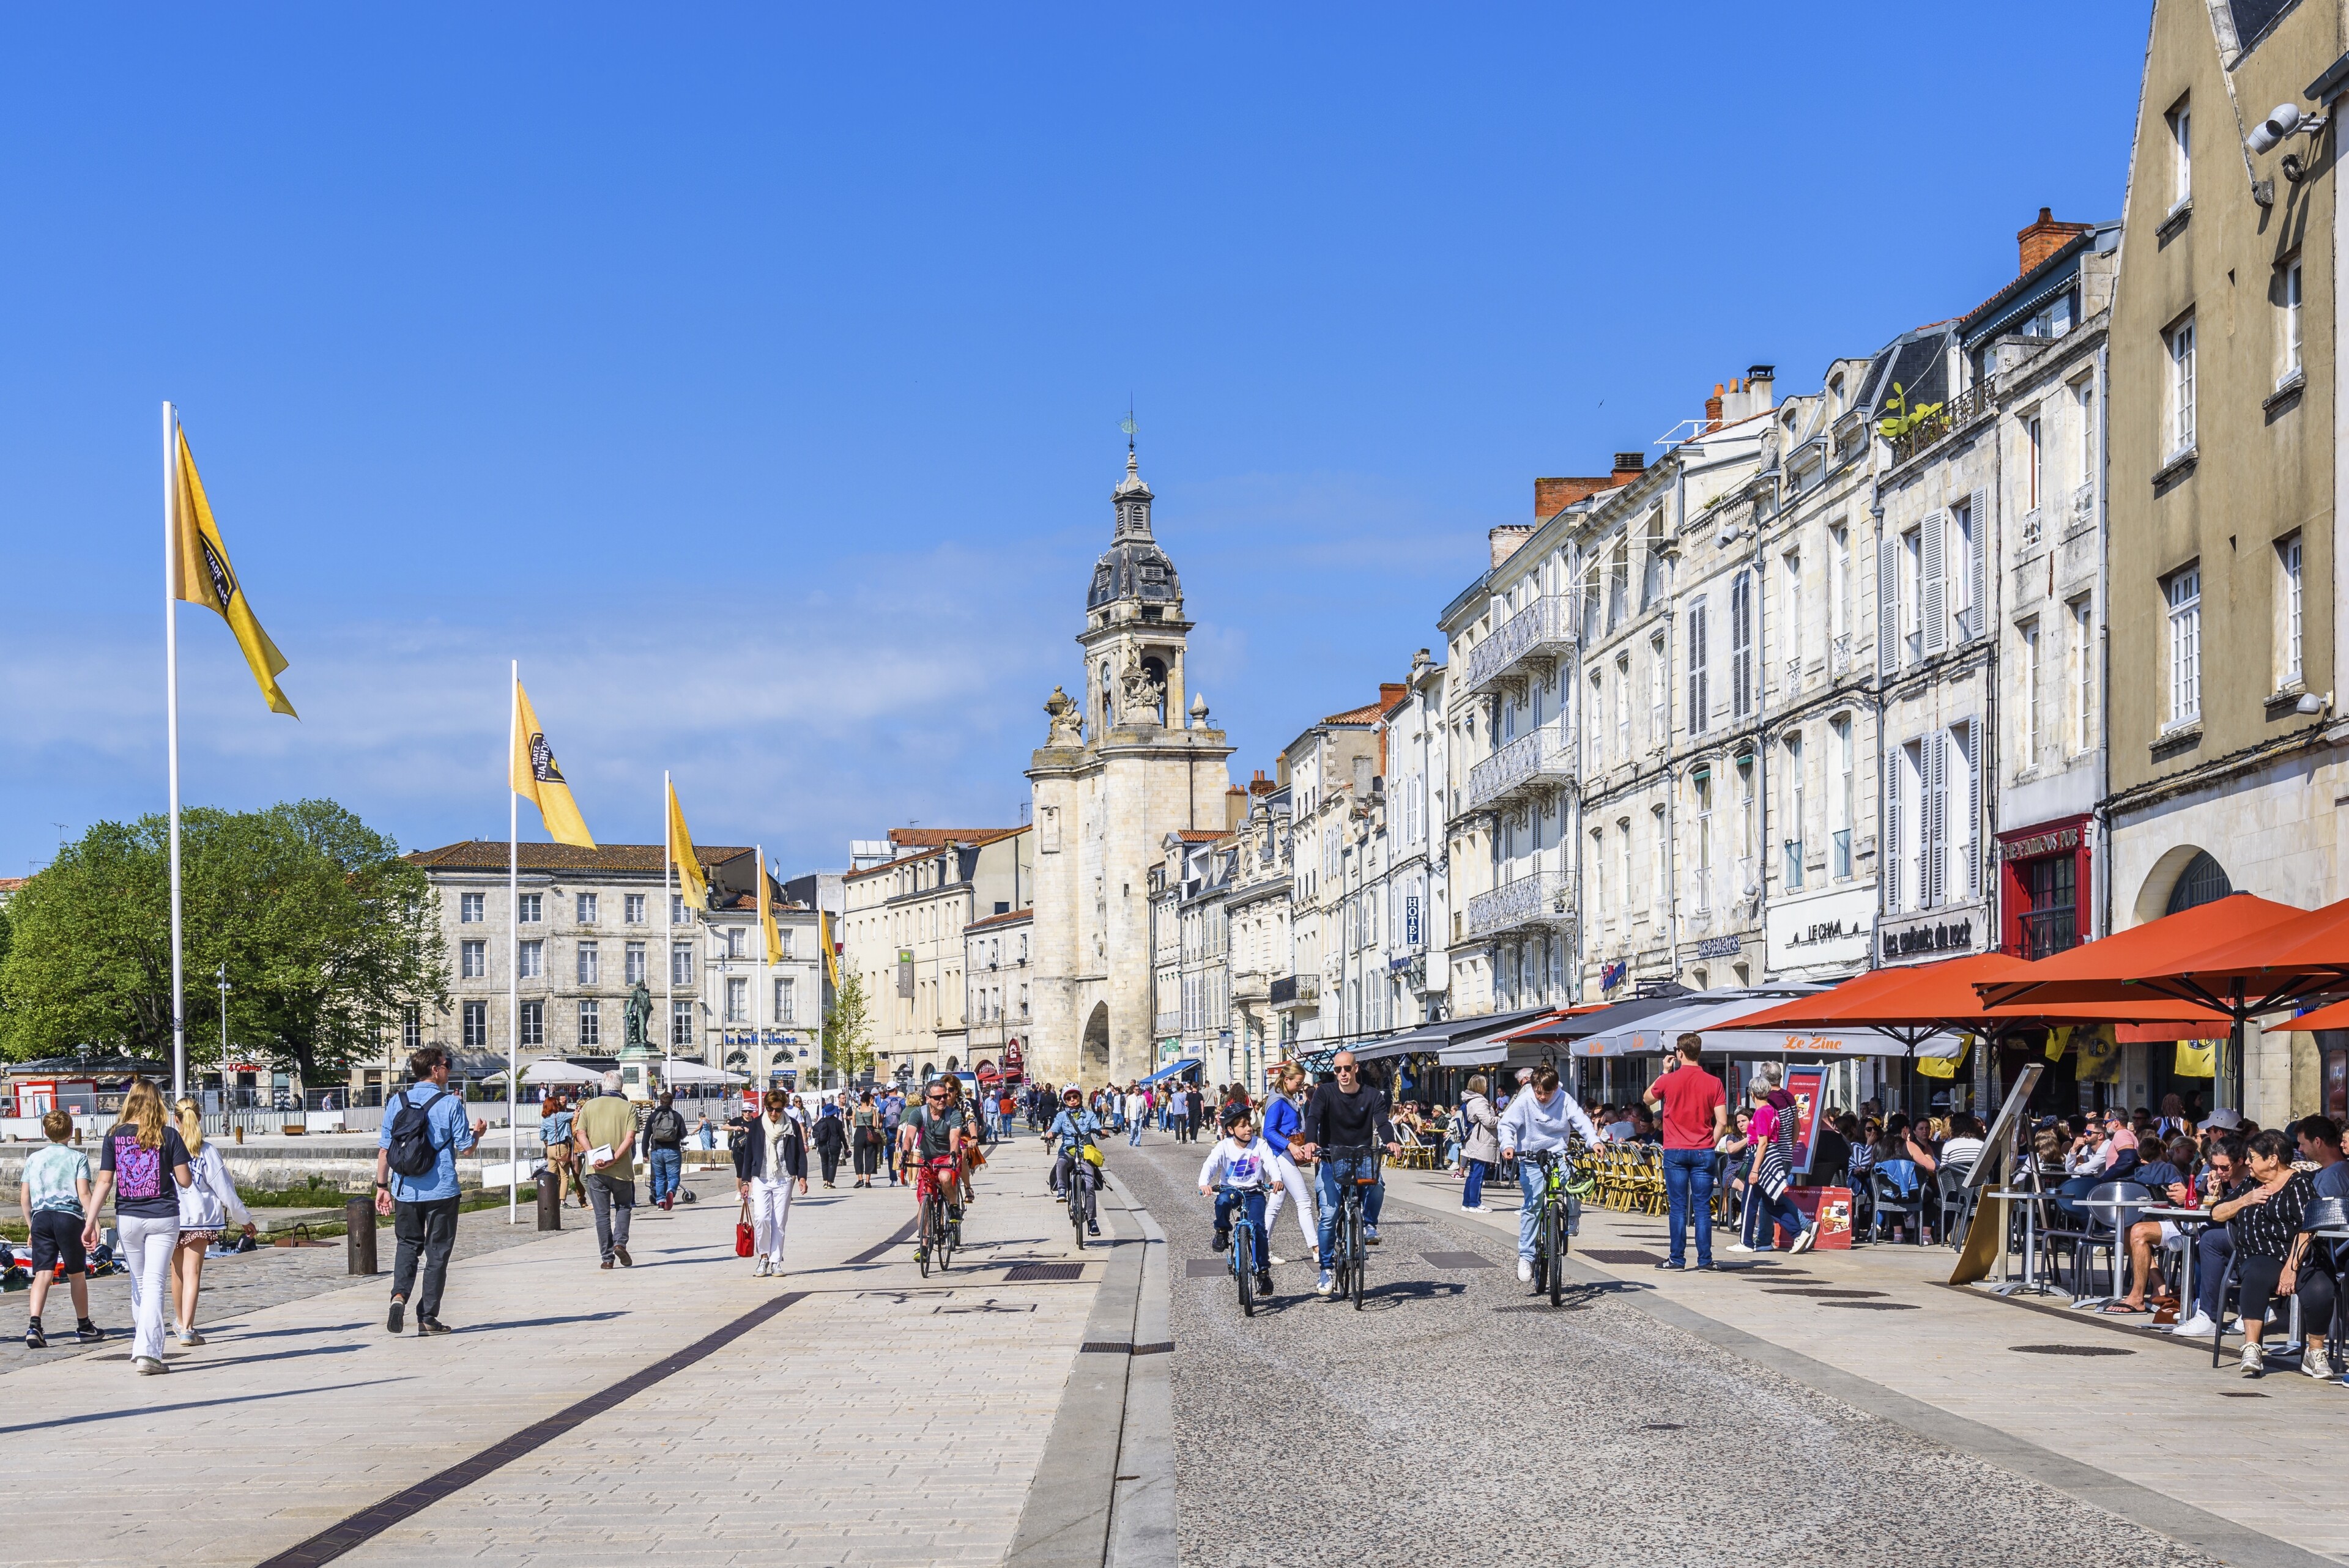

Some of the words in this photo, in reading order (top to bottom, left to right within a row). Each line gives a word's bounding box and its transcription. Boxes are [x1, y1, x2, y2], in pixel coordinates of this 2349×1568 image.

[206, 550, 223, 580] STADE
[1998, 841, 2018, 861] THE
[2019, 832, 2058, 857] FAMOUS
[2059, 828, 2079, 849] PUB
[1408, 897, 1417, 944] HOTEL
[1808, 924, 1817, 941] LE
[1883, 930, 1898, 954] Les
[1899, 924, 1934, 952] enfants
[1935, 921, 1948, 948] du
[1949, 917, 1972, 945] rock
[1698, 940, 1711, 957] LES
[725, 1034, 735, 1045] la
[737, 1035, 798, 1045] bell-iloise
[1782, 1035, 1805, 1049] Le
[1808, 1037, 1842, 1049] Zinc
[115, 1136, 125, 1145] NO
